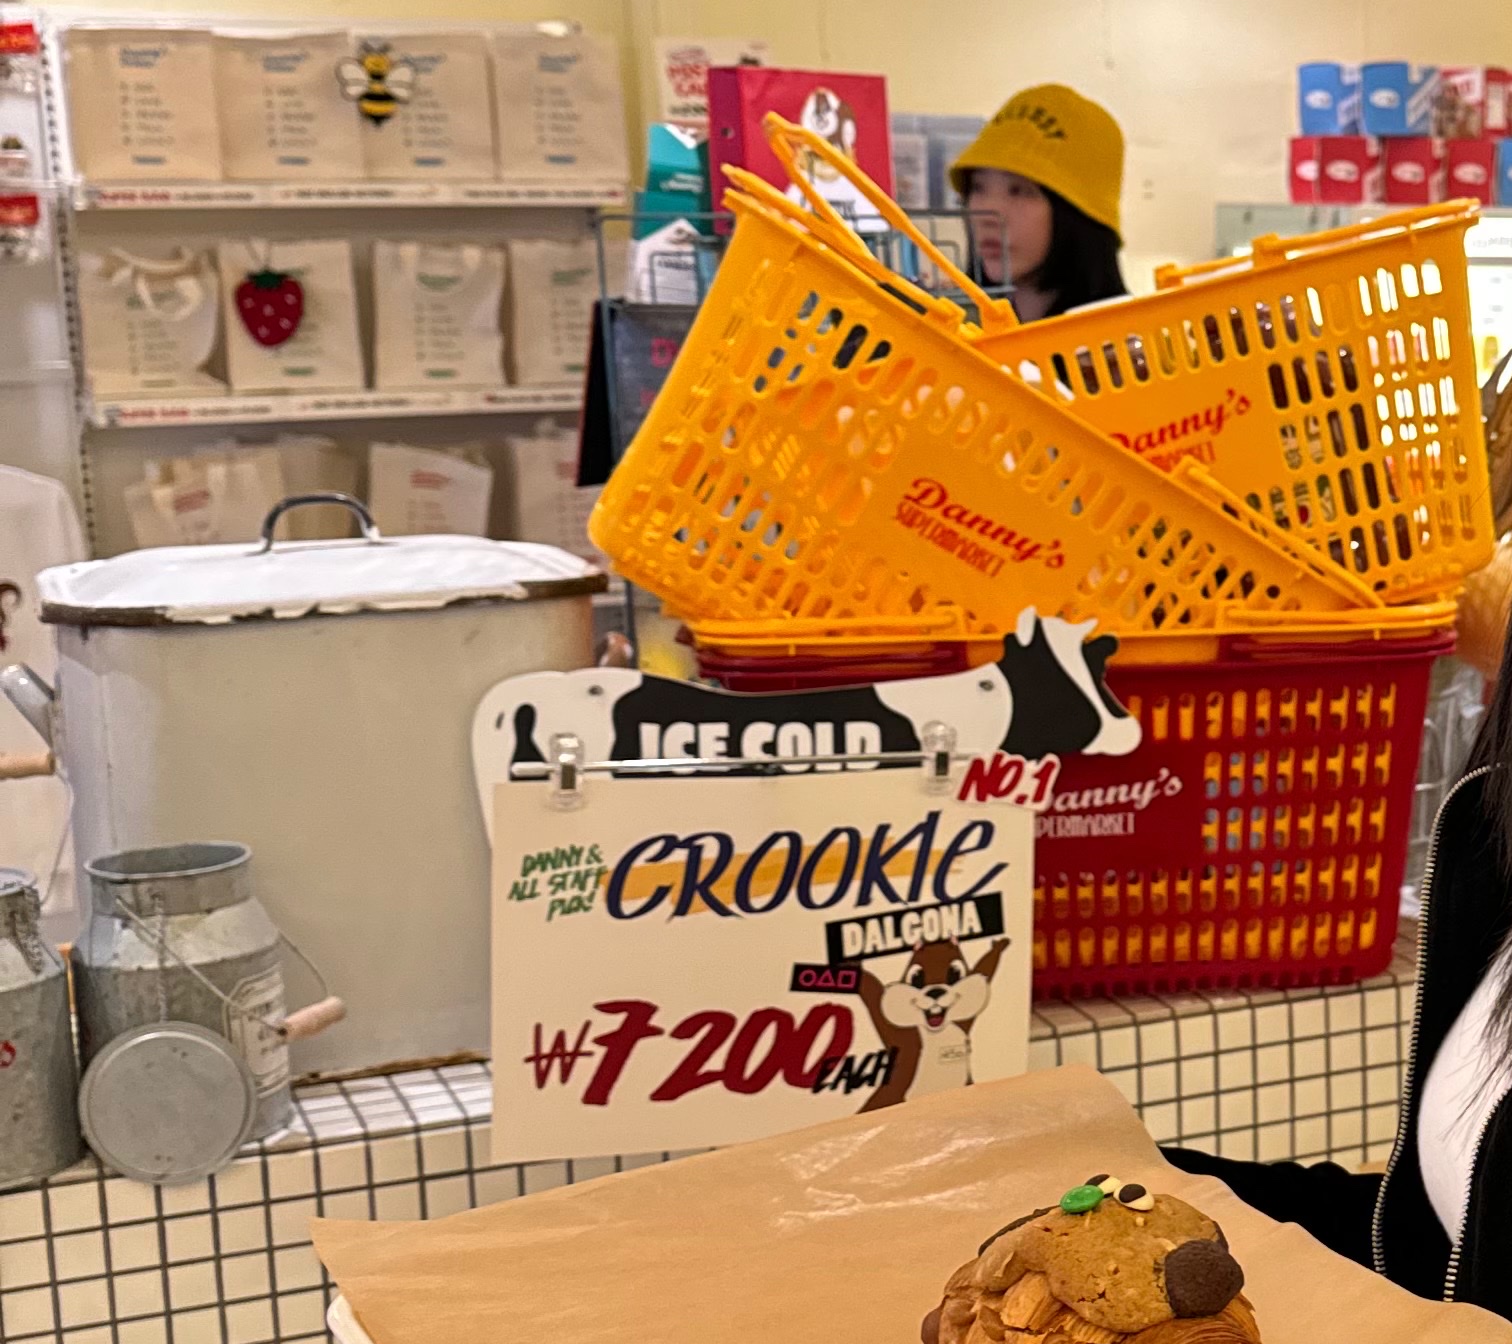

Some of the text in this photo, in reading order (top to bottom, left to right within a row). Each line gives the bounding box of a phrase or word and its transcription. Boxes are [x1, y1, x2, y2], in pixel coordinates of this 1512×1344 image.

[902, 478, 1066, 569] Danny's
[639, 722, 882, 774] ICE COLD
[957, 751, 1057, 807] NO.1
[1052, 767, 1183, 810] anny's
[508, 865, 608, 902] ALL STAFF
[520, 843, 603, 877] DANNY &
[546, 890, 596, 922] PICK!
[842, 901, 982, 958] DALGONA
[812, 1046, 897, 1095] EACH
